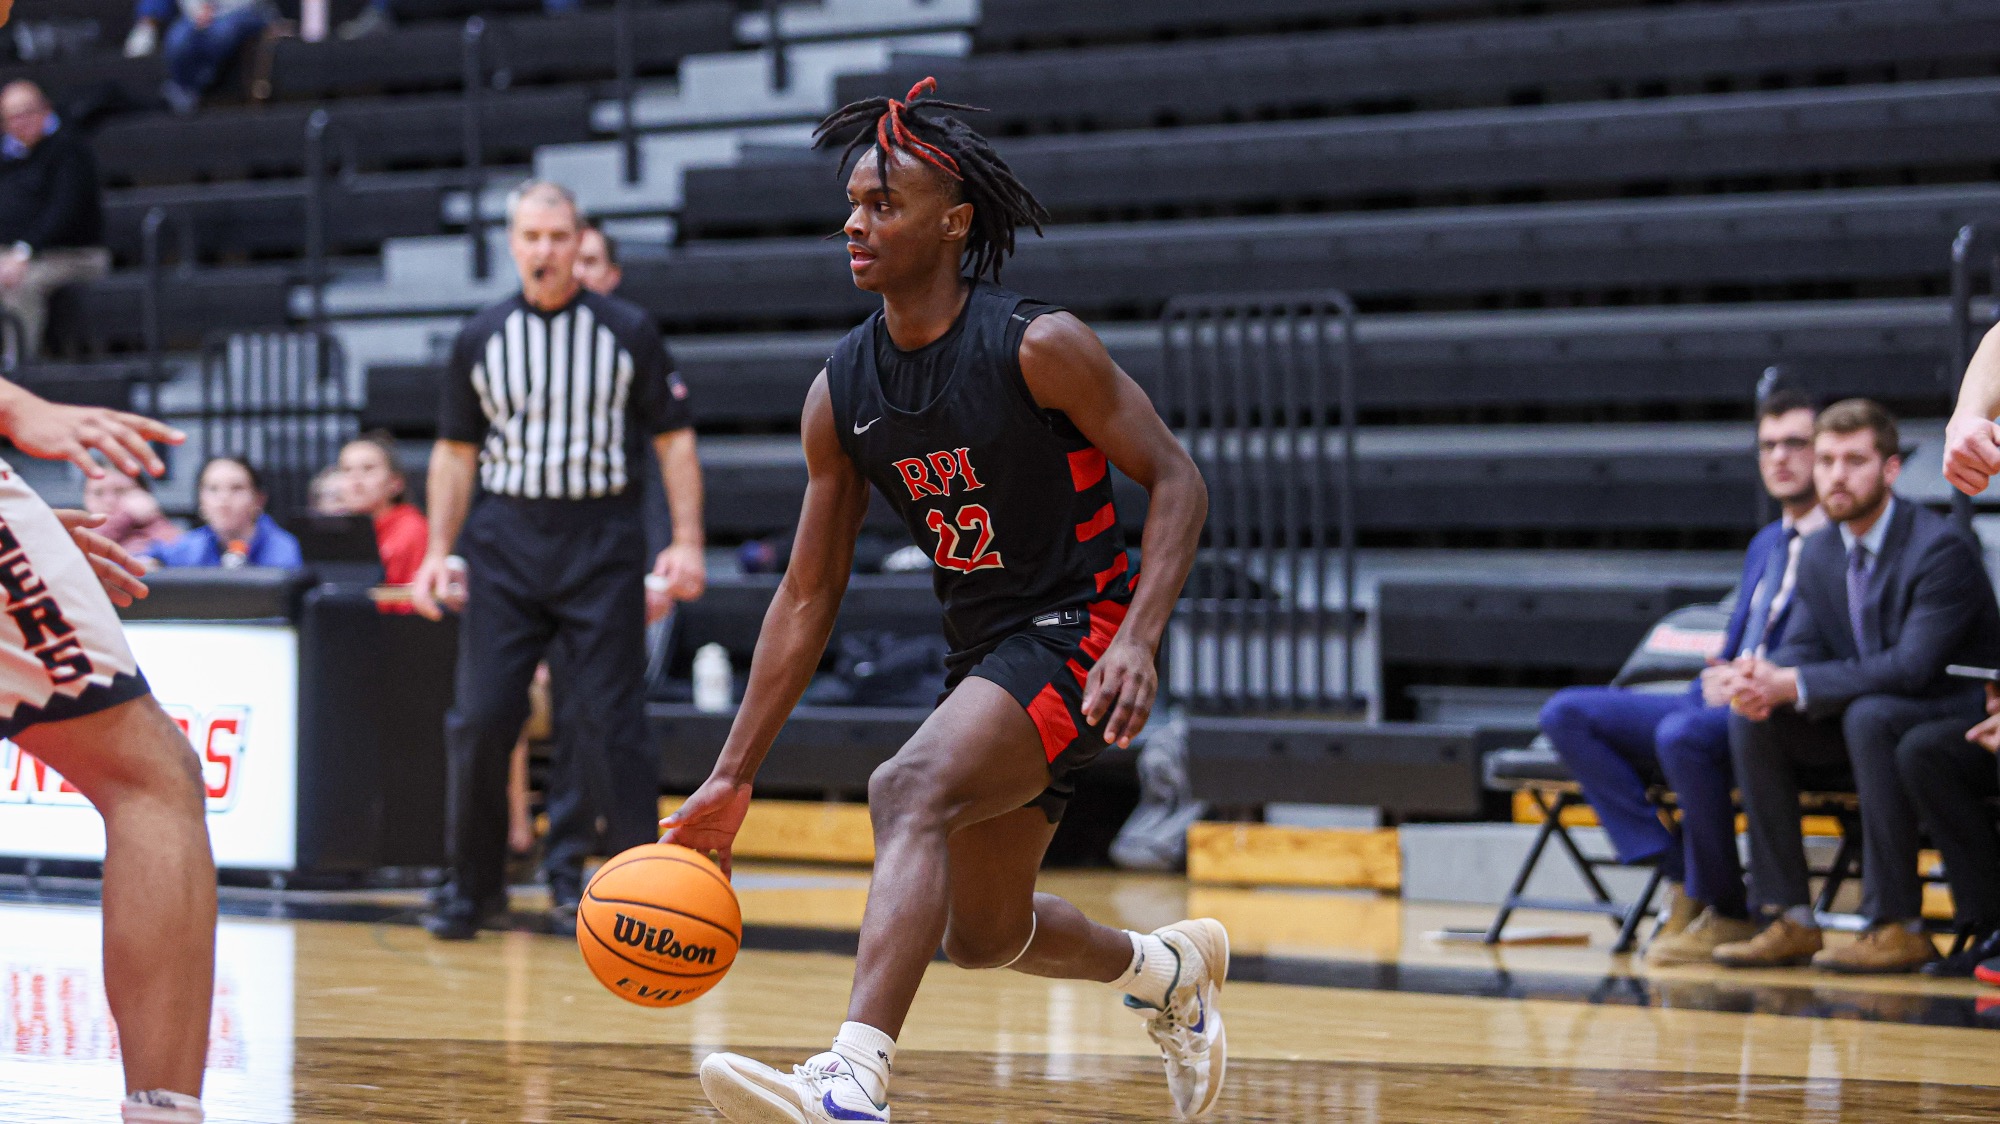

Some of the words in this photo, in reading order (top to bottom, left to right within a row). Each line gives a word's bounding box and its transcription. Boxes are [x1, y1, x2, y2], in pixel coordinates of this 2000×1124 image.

[892, 447, 985, 500] RPI
[926, 503, 1004, 574] 22
[1064, 611, 1072, 620] L
[613, 913, 716, 965] Wilson
